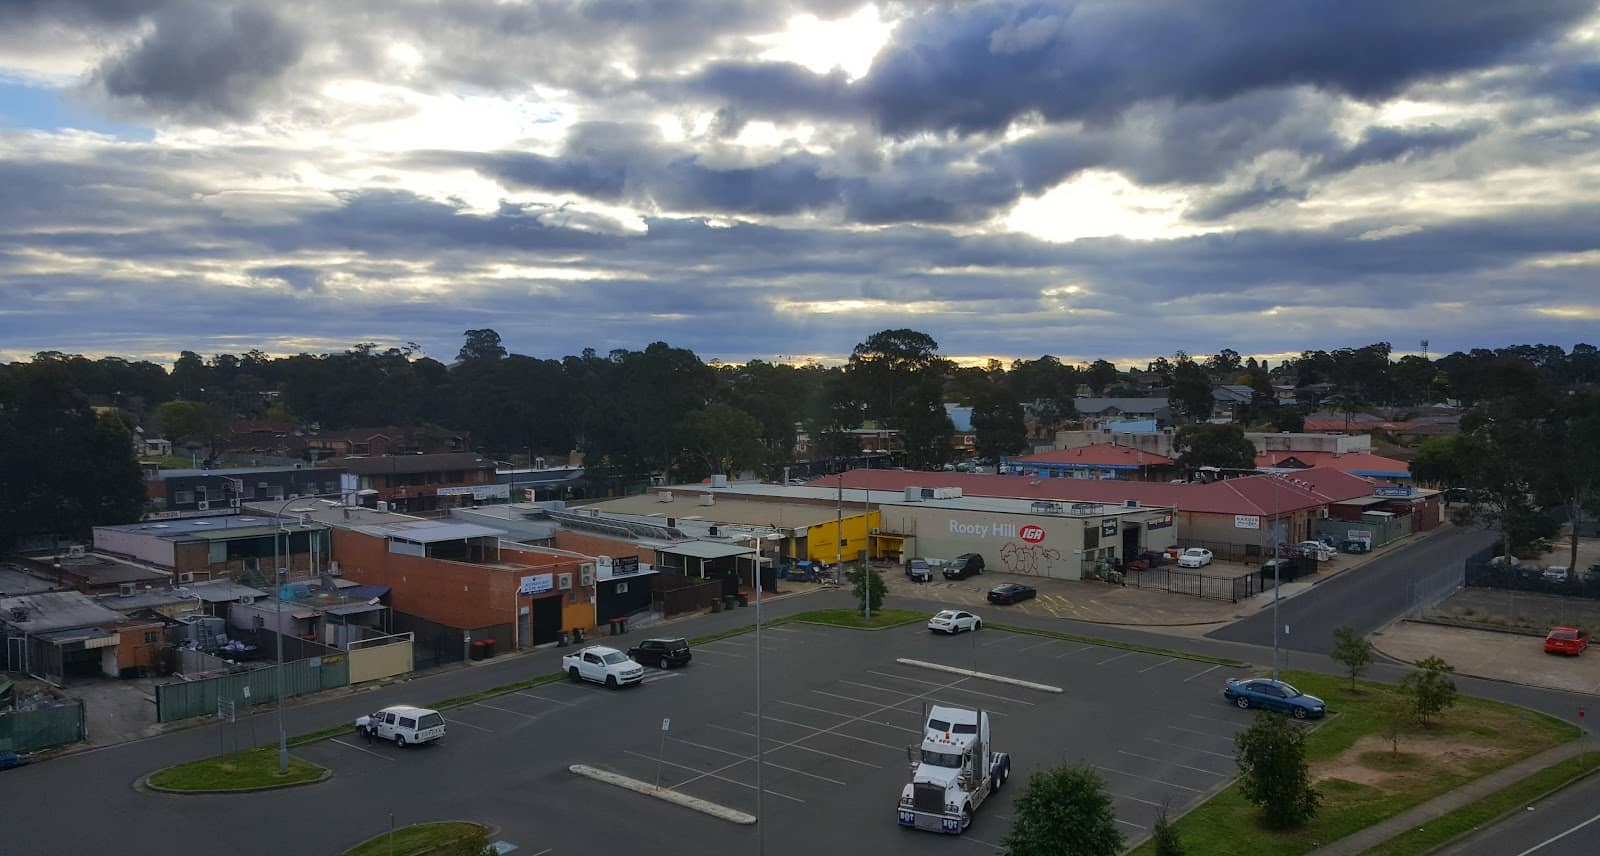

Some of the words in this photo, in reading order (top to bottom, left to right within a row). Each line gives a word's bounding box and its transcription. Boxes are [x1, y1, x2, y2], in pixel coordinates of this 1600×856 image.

[949, 519, 988, 538] Rooty
[992, 521, 1016, 537] Hill
[1022, 527, 1043, 540] IGA
